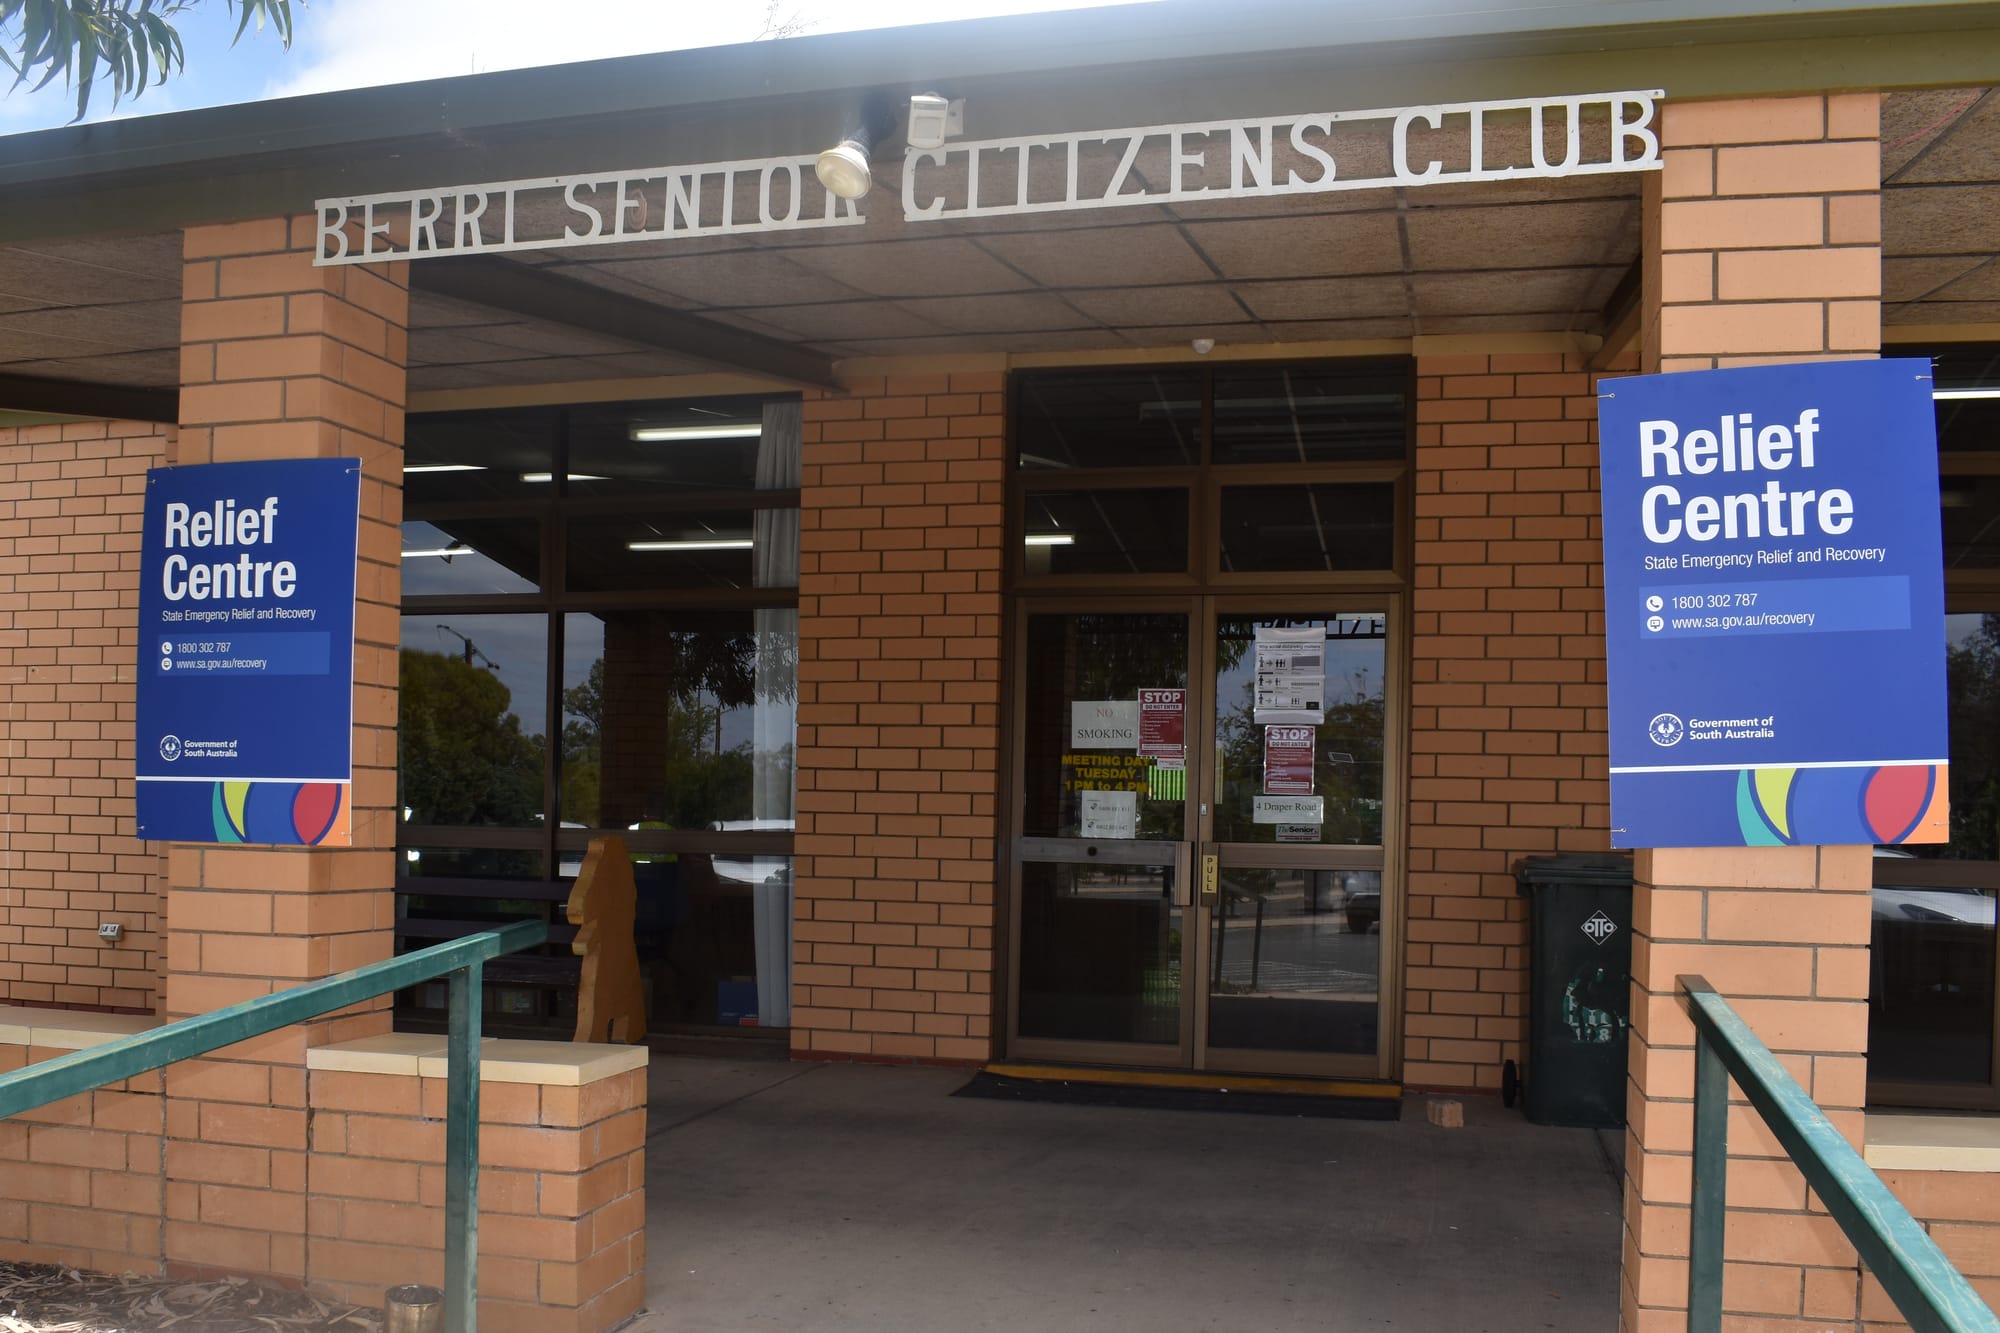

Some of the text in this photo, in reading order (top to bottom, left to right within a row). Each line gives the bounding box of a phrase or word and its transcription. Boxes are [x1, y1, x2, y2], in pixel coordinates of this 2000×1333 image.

[315, 187, 516, 265] BERRI
[902, 113, 1338, 221] CITIZENS
[1392, 90, 1662, 185] CLUB
[1638, 408, 1821, 478] Relief
[1641, 480, 1855, 545] Centre
[164, 496, 279, 549] Relief
[1644, 547, 1886, 571] State Emergency Relief and Recovery
[162, 553, 297, 601] Centre
[1672, 593, 1758, 609] 1800 302 787
[161, 607, 317, 623] State Emergency Relief and Recovery
[1672, 612, 1816, 630] www.sa.gov.au/recovery
[177, 642, 231, 654] 1800 302 787
[176, 657, 268, 671] www.sa.gov.au/recovery
[1144, 691, 1181, 703] STOP
[1096, 708, 1114, 718] NO
[1689, 716, 1774, 728] Government of
[1077, 729, 1132, 739] SMOKING
[1271, 729, 1309, 740] STOP
[1689, 728, 1775, 740] South Australia
[184, 740, 238, 748] Government of
[184, 749, 238, 758] South Australia
[1061, 755, 1121, 766] MEETING
[1075, 768, 1137, 779] TUESDAY
[1074, 781, 1094, 791] PM
[1100, 781, 1112, 791] to
[1115, 781, 1124, 791] 4
[1127, 781, 1149, 792] PM
[1256, 802, 1317, 813] 4 Draper Road
[1289, 825, 1313, 833] Senior
[1206, 857, 1214, 892] PULL
